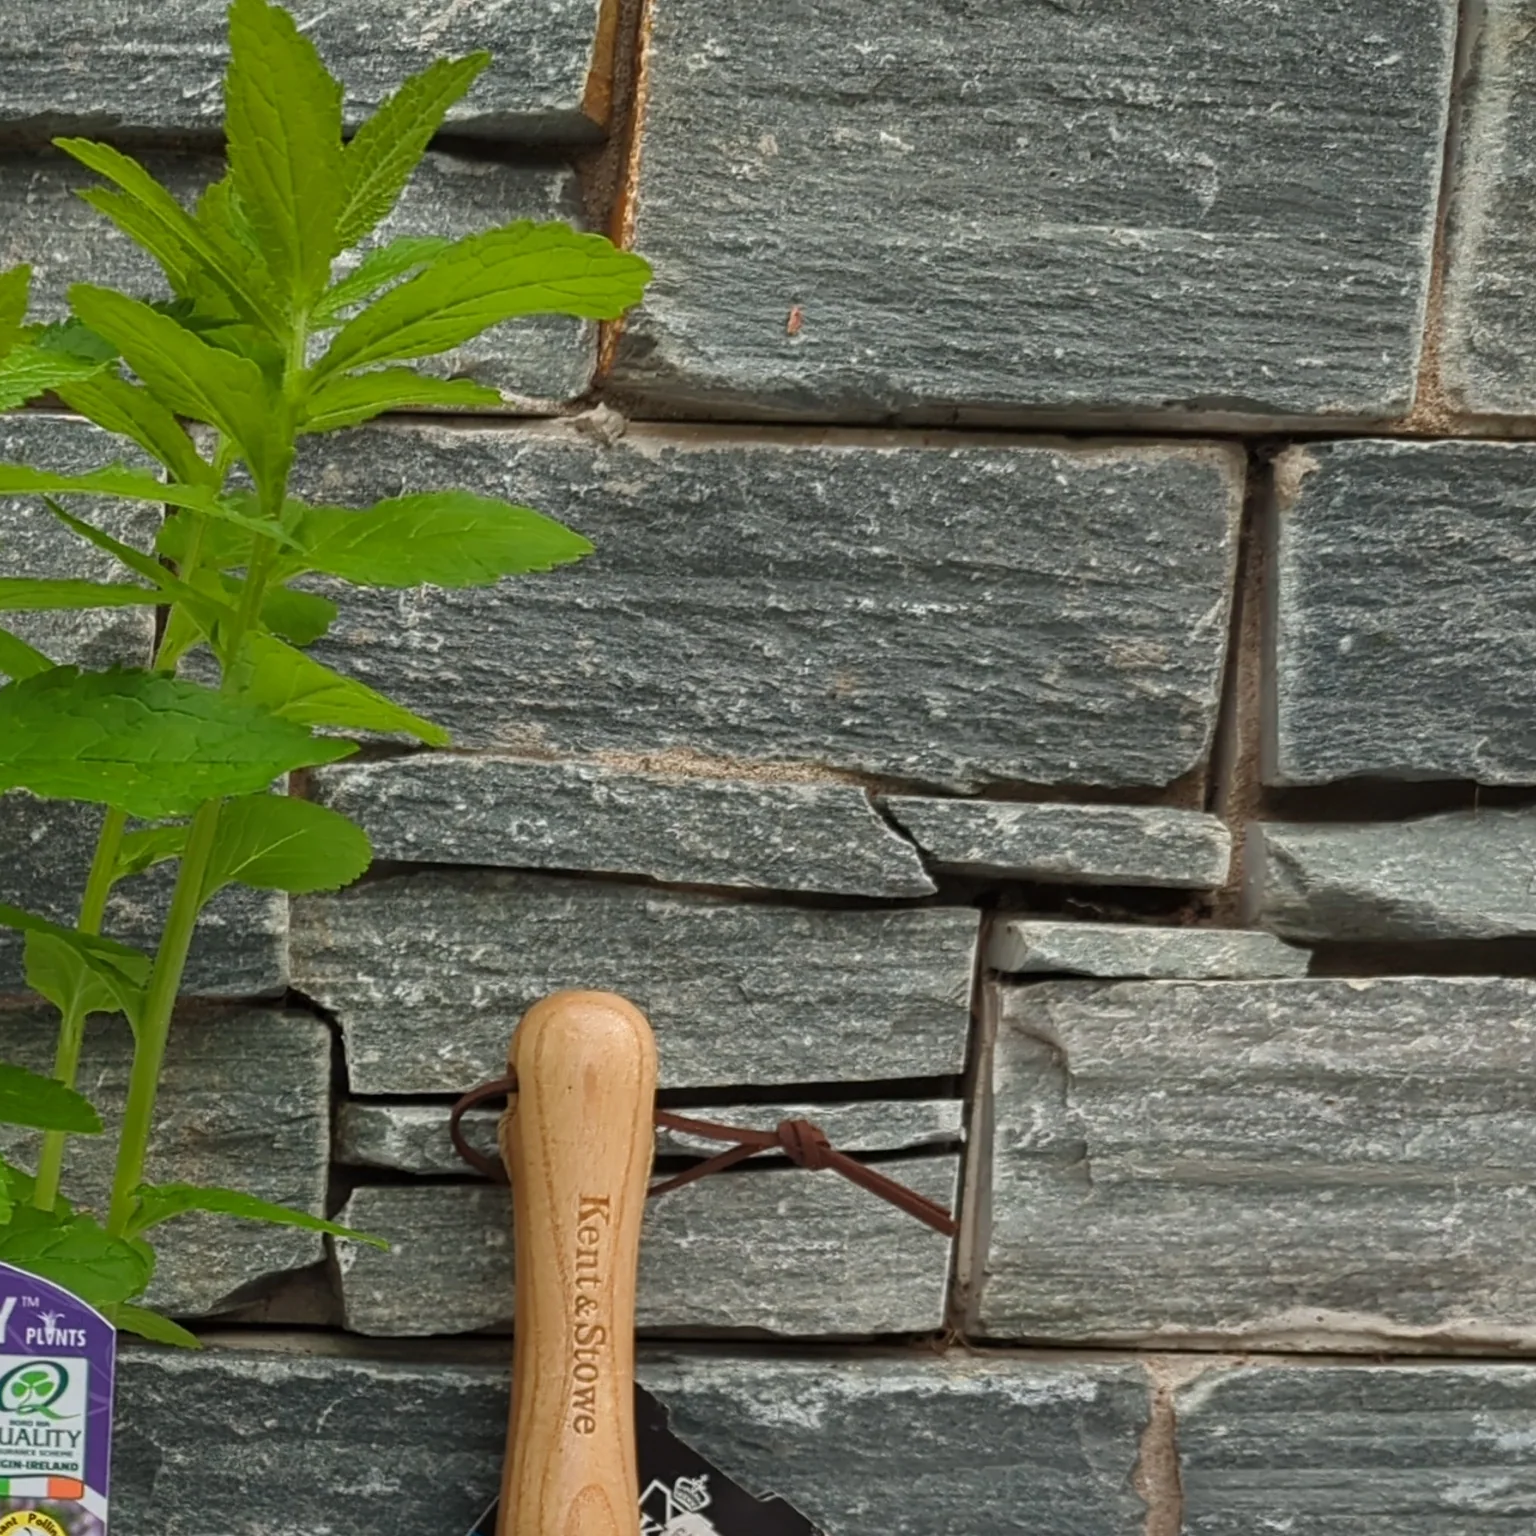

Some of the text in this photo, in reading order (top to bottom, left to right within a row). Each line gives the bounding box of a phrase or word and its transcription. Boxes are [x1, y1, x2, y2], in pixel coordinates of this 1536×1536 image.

[572, 1193, 612, 1436] Kent & Stowe
[39, 1449, 74, 1458] SCHEME
